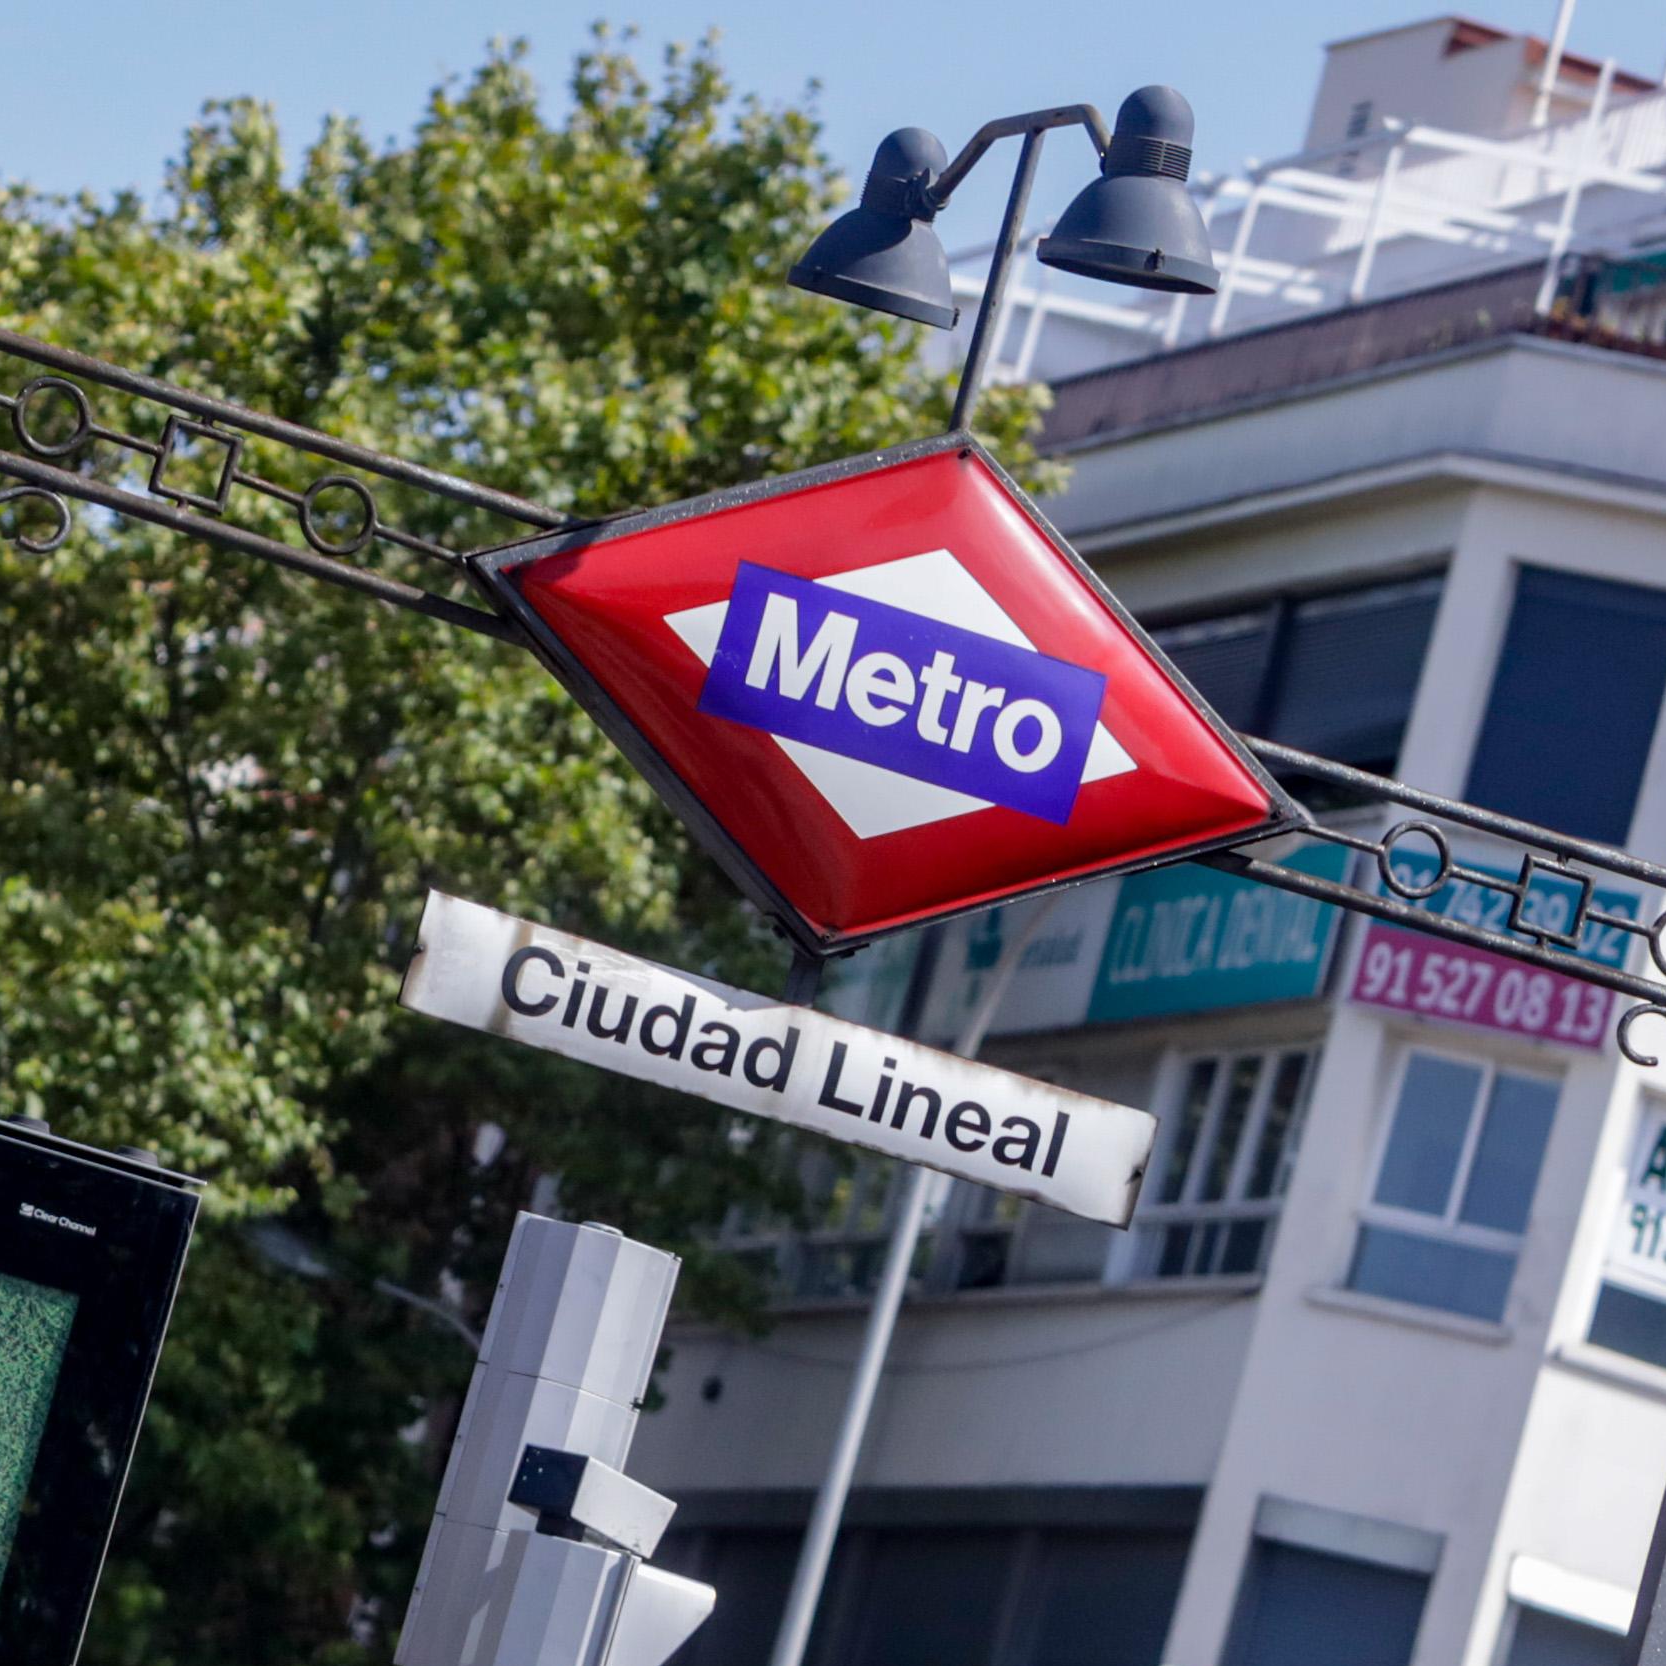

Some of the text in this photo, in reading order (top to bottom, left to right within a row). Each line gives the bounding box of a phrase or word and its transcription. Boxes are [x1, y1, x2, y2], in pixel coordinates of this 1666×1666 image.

[744, 592, 1062, 774] Metro
[502, 945, 1071, 1178] Ciudad Lineal
[1362, 942, 1609, 1042] 91 527 08 13
[33, 1207, 98, 1237] Clear Channel
